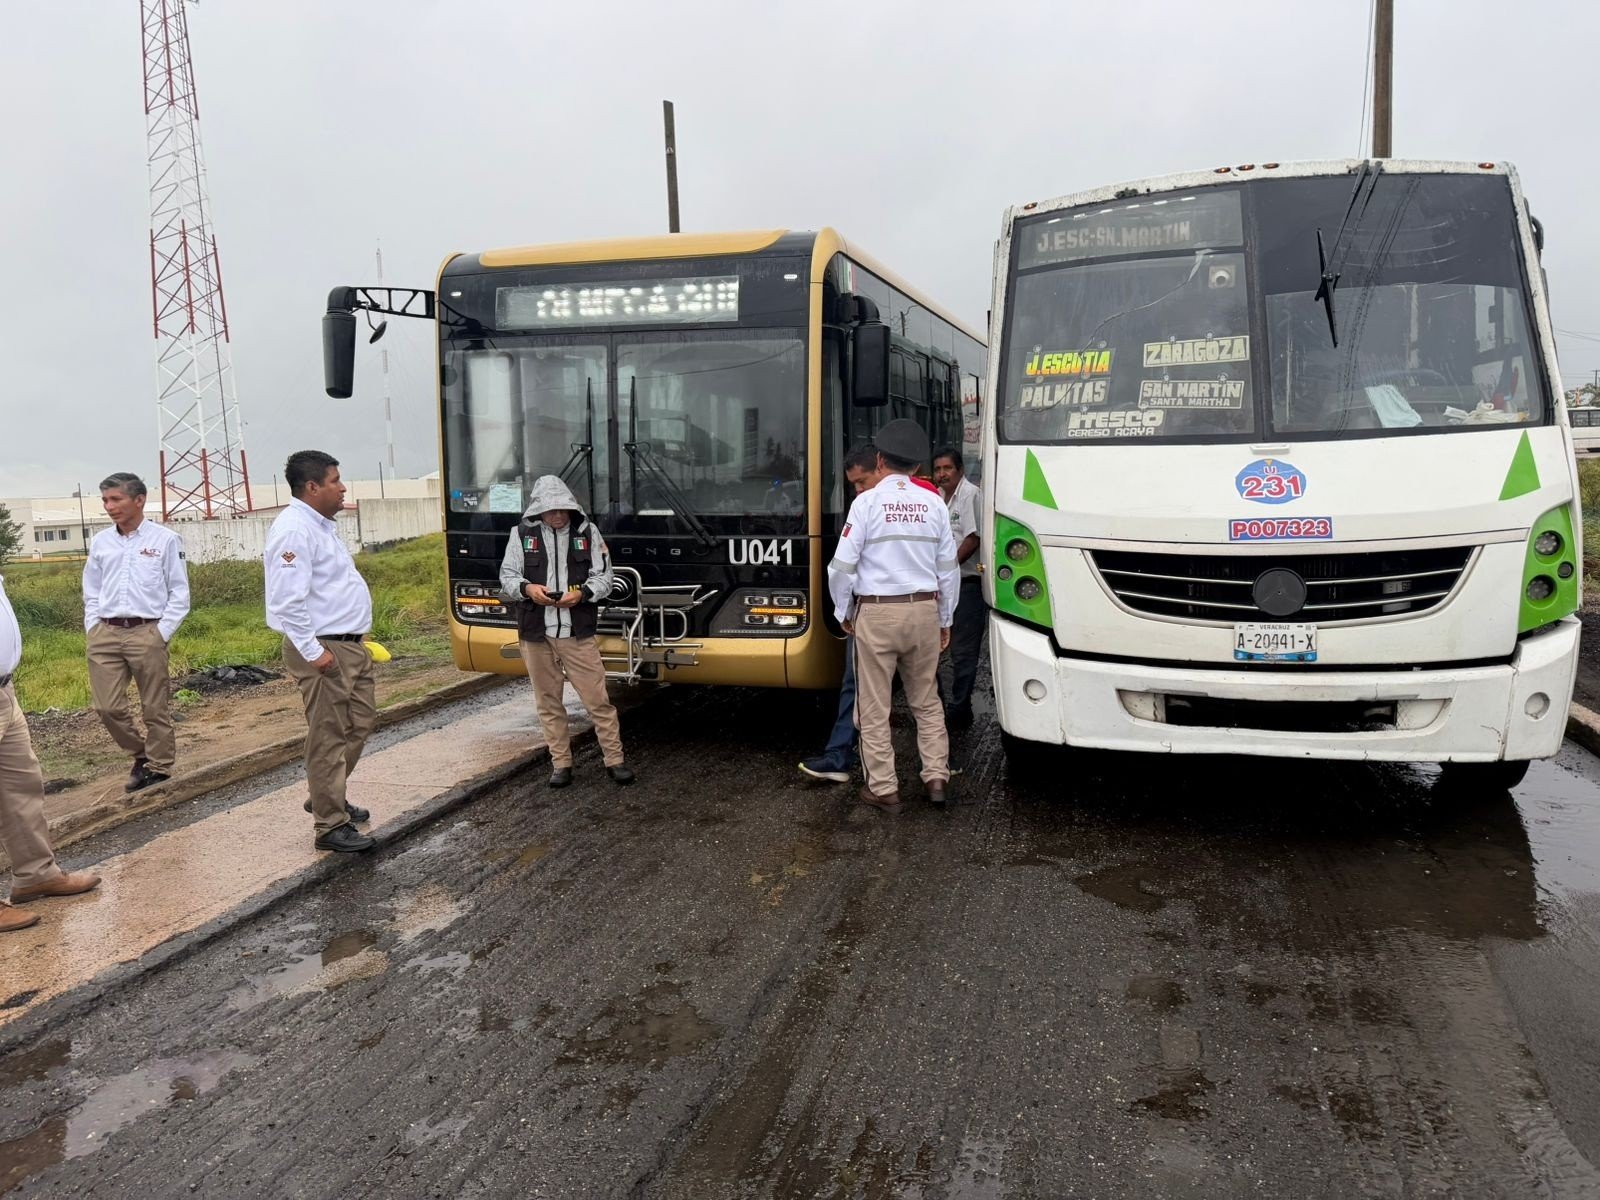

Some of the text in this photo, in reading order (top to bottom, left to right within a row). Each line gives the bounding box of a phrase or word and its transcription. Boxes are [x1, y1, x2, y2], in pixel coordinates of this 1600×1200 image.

[1146, 339, 1246, 365] ZARAGOZA
[1026, 351, 1110, 375] J.ESCUTIA
[1020, 381, 1107, 408] PALMITAS
[1143, 383, 1241, 398] SAN MARTIN
[1150, 398, 1230, 407] SANTA MARTHA
[1068, 429, 1110, 437] CERESO
[1242, 475, 1302, 498] 231
[882, 500, 929, 513] TRÁNSITO
[885, 513, 927, 523] ESTATAL
[1231, 519, 1331, 538] P007323
[728, 538, 793, 565] U041
